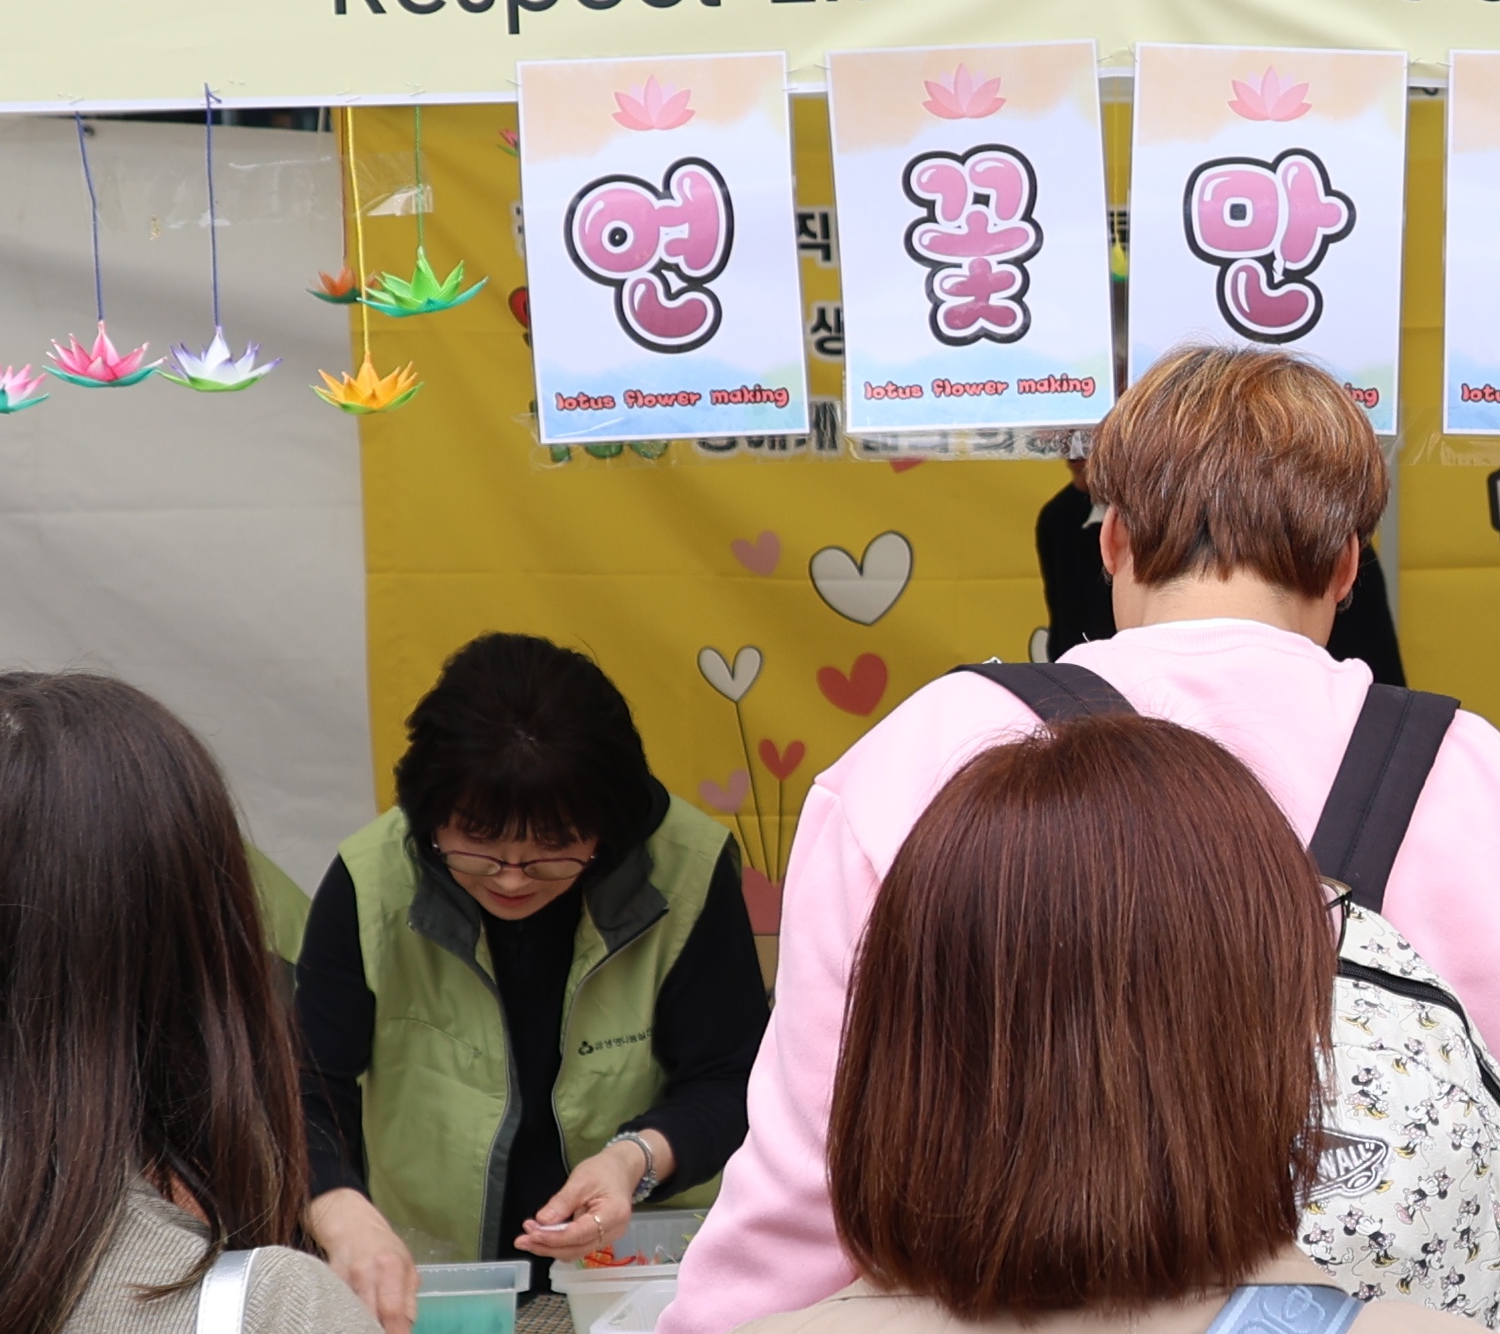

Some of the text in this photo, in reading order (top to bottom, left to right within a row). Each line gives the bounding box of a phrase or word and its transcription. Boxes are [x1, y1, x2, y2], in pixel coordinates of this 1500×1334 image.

[564, 156, 734, 354] 연
[902, 143, 1043, 347] 꽃
[1183, 148, 1357, 343] 만
[554, 385, 790, 413] lotus flower making
[863, 374, 1096, 402] lotus flower making
